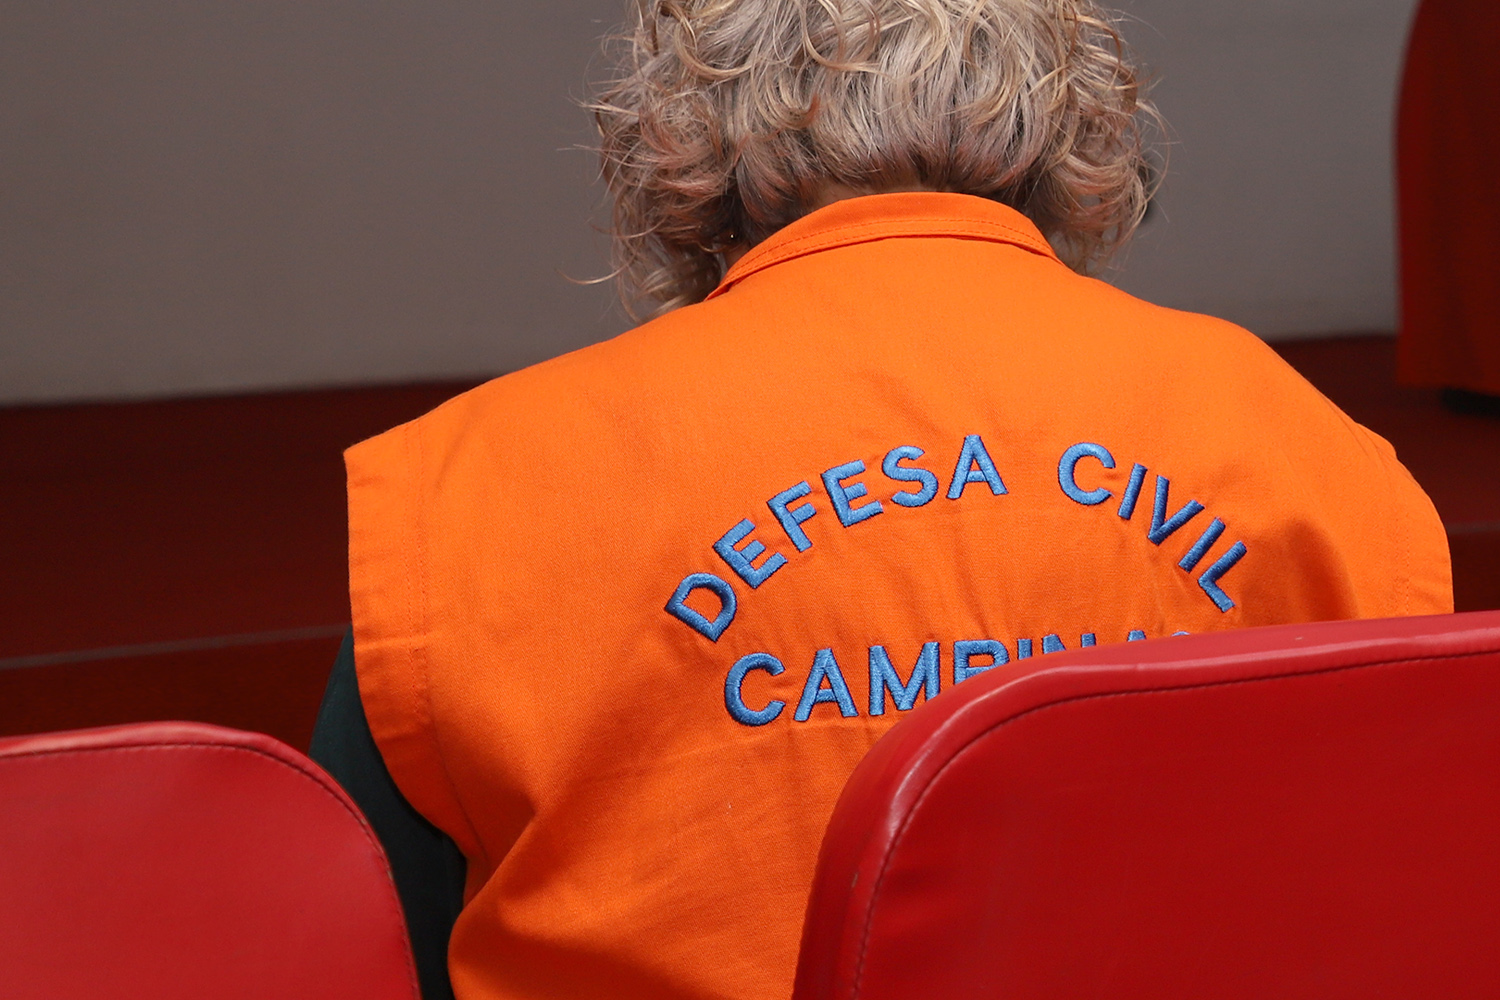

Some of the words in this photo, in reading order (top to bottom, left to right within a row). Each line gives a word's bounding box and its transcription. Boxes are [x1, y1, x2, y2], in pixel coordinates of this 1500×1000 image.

[664, 434, 1008, 642] DEFESA
[1057, 442, 1247, 613] CIVIL
[724, 630, 1194, 727] CAMP
